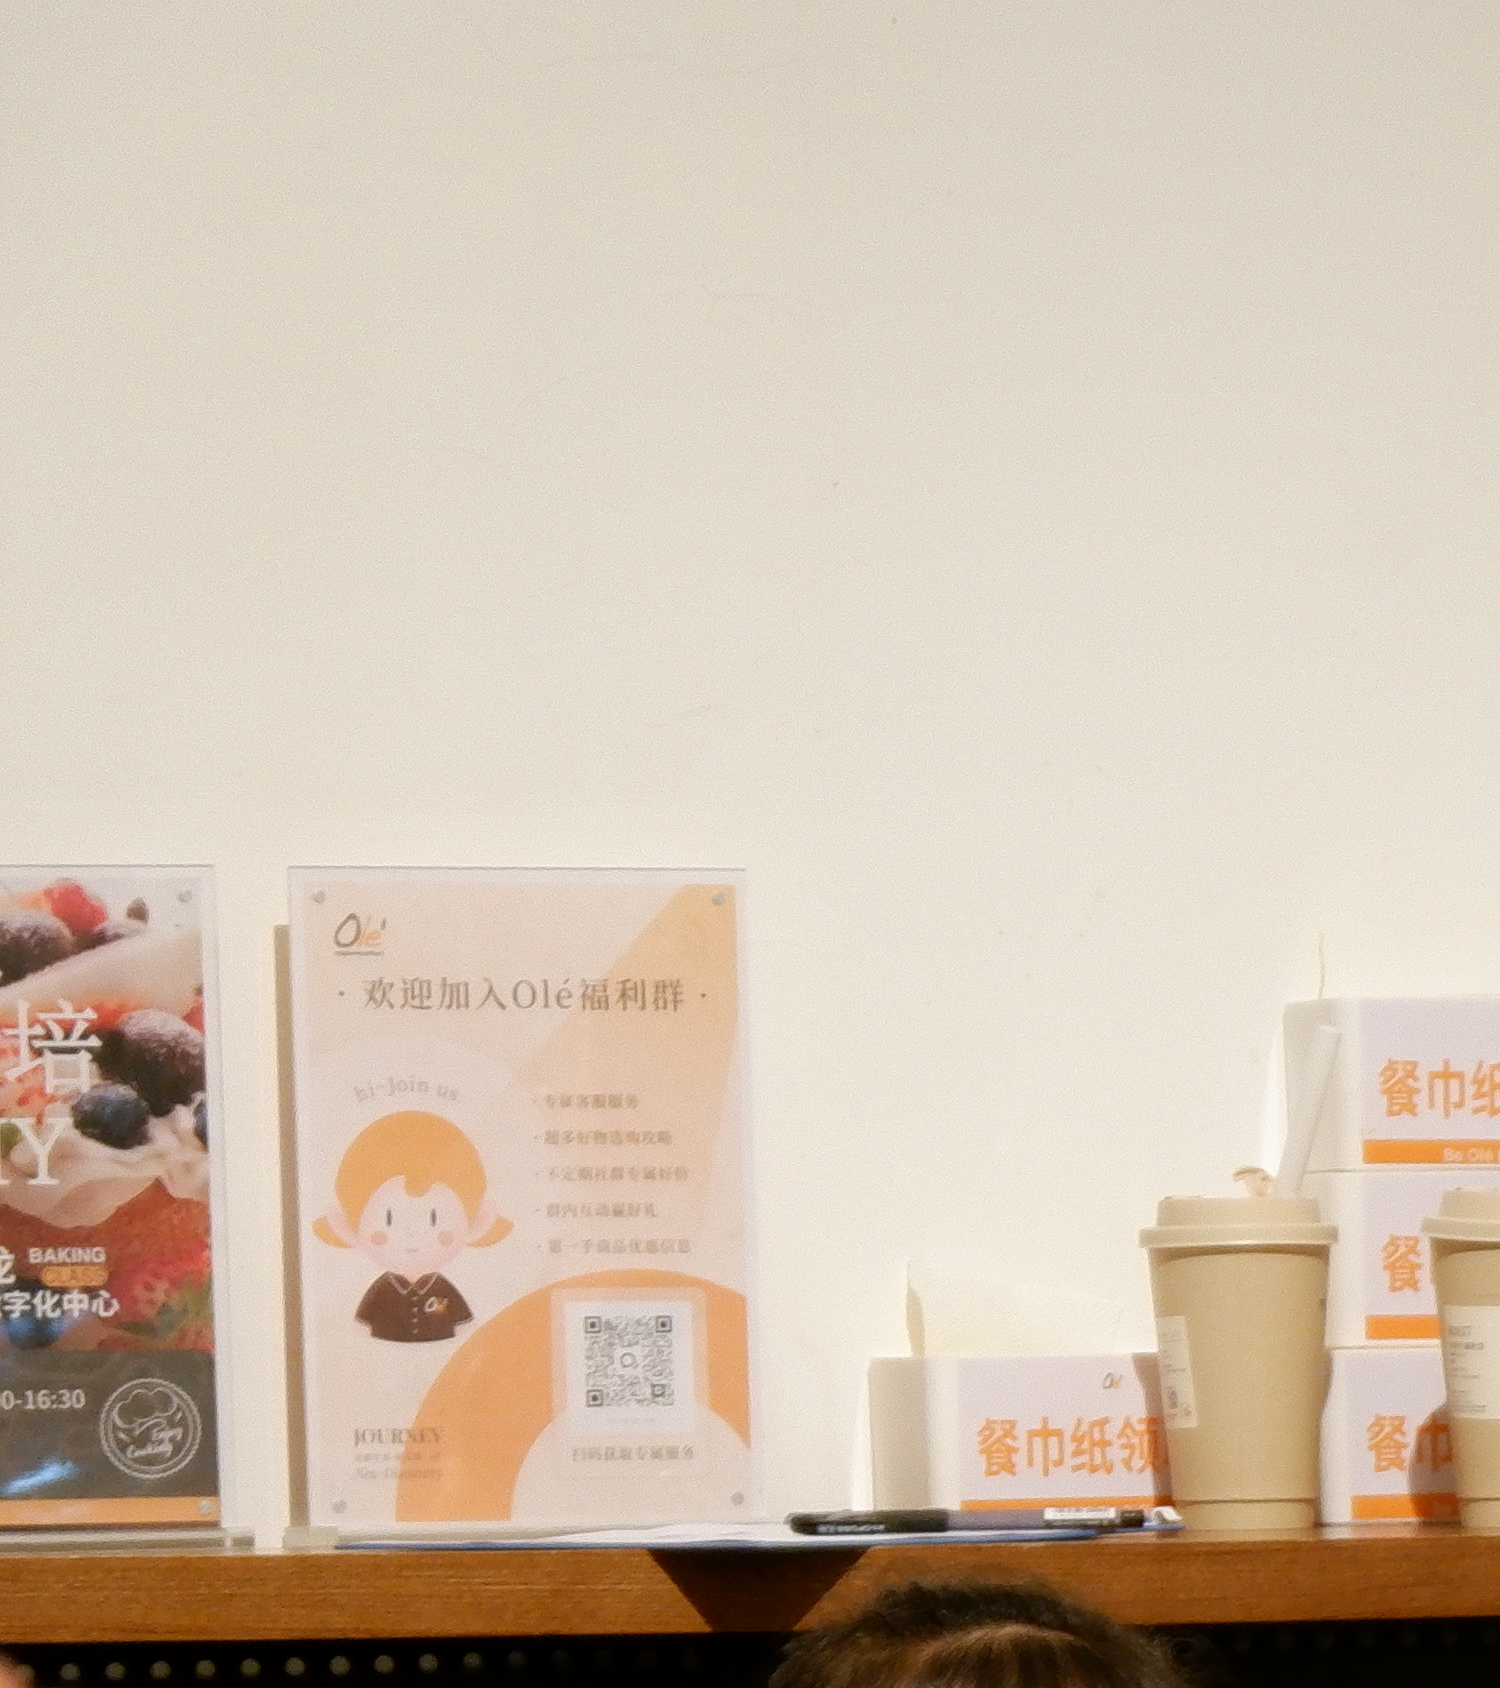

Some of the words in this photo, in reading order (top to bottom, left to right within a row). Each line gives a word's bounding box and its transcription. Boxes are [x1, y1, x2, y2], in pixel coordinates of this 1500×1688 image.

[364, 976, 685, 1012] 欢迎加入Olé福利群
[2, 999, 104, 1094] 培
[0, 1117, 75, 1186] Y
[28, 1246, 107, 1264] BAKING
[0, 1289, 121, 1318] 字化中心
